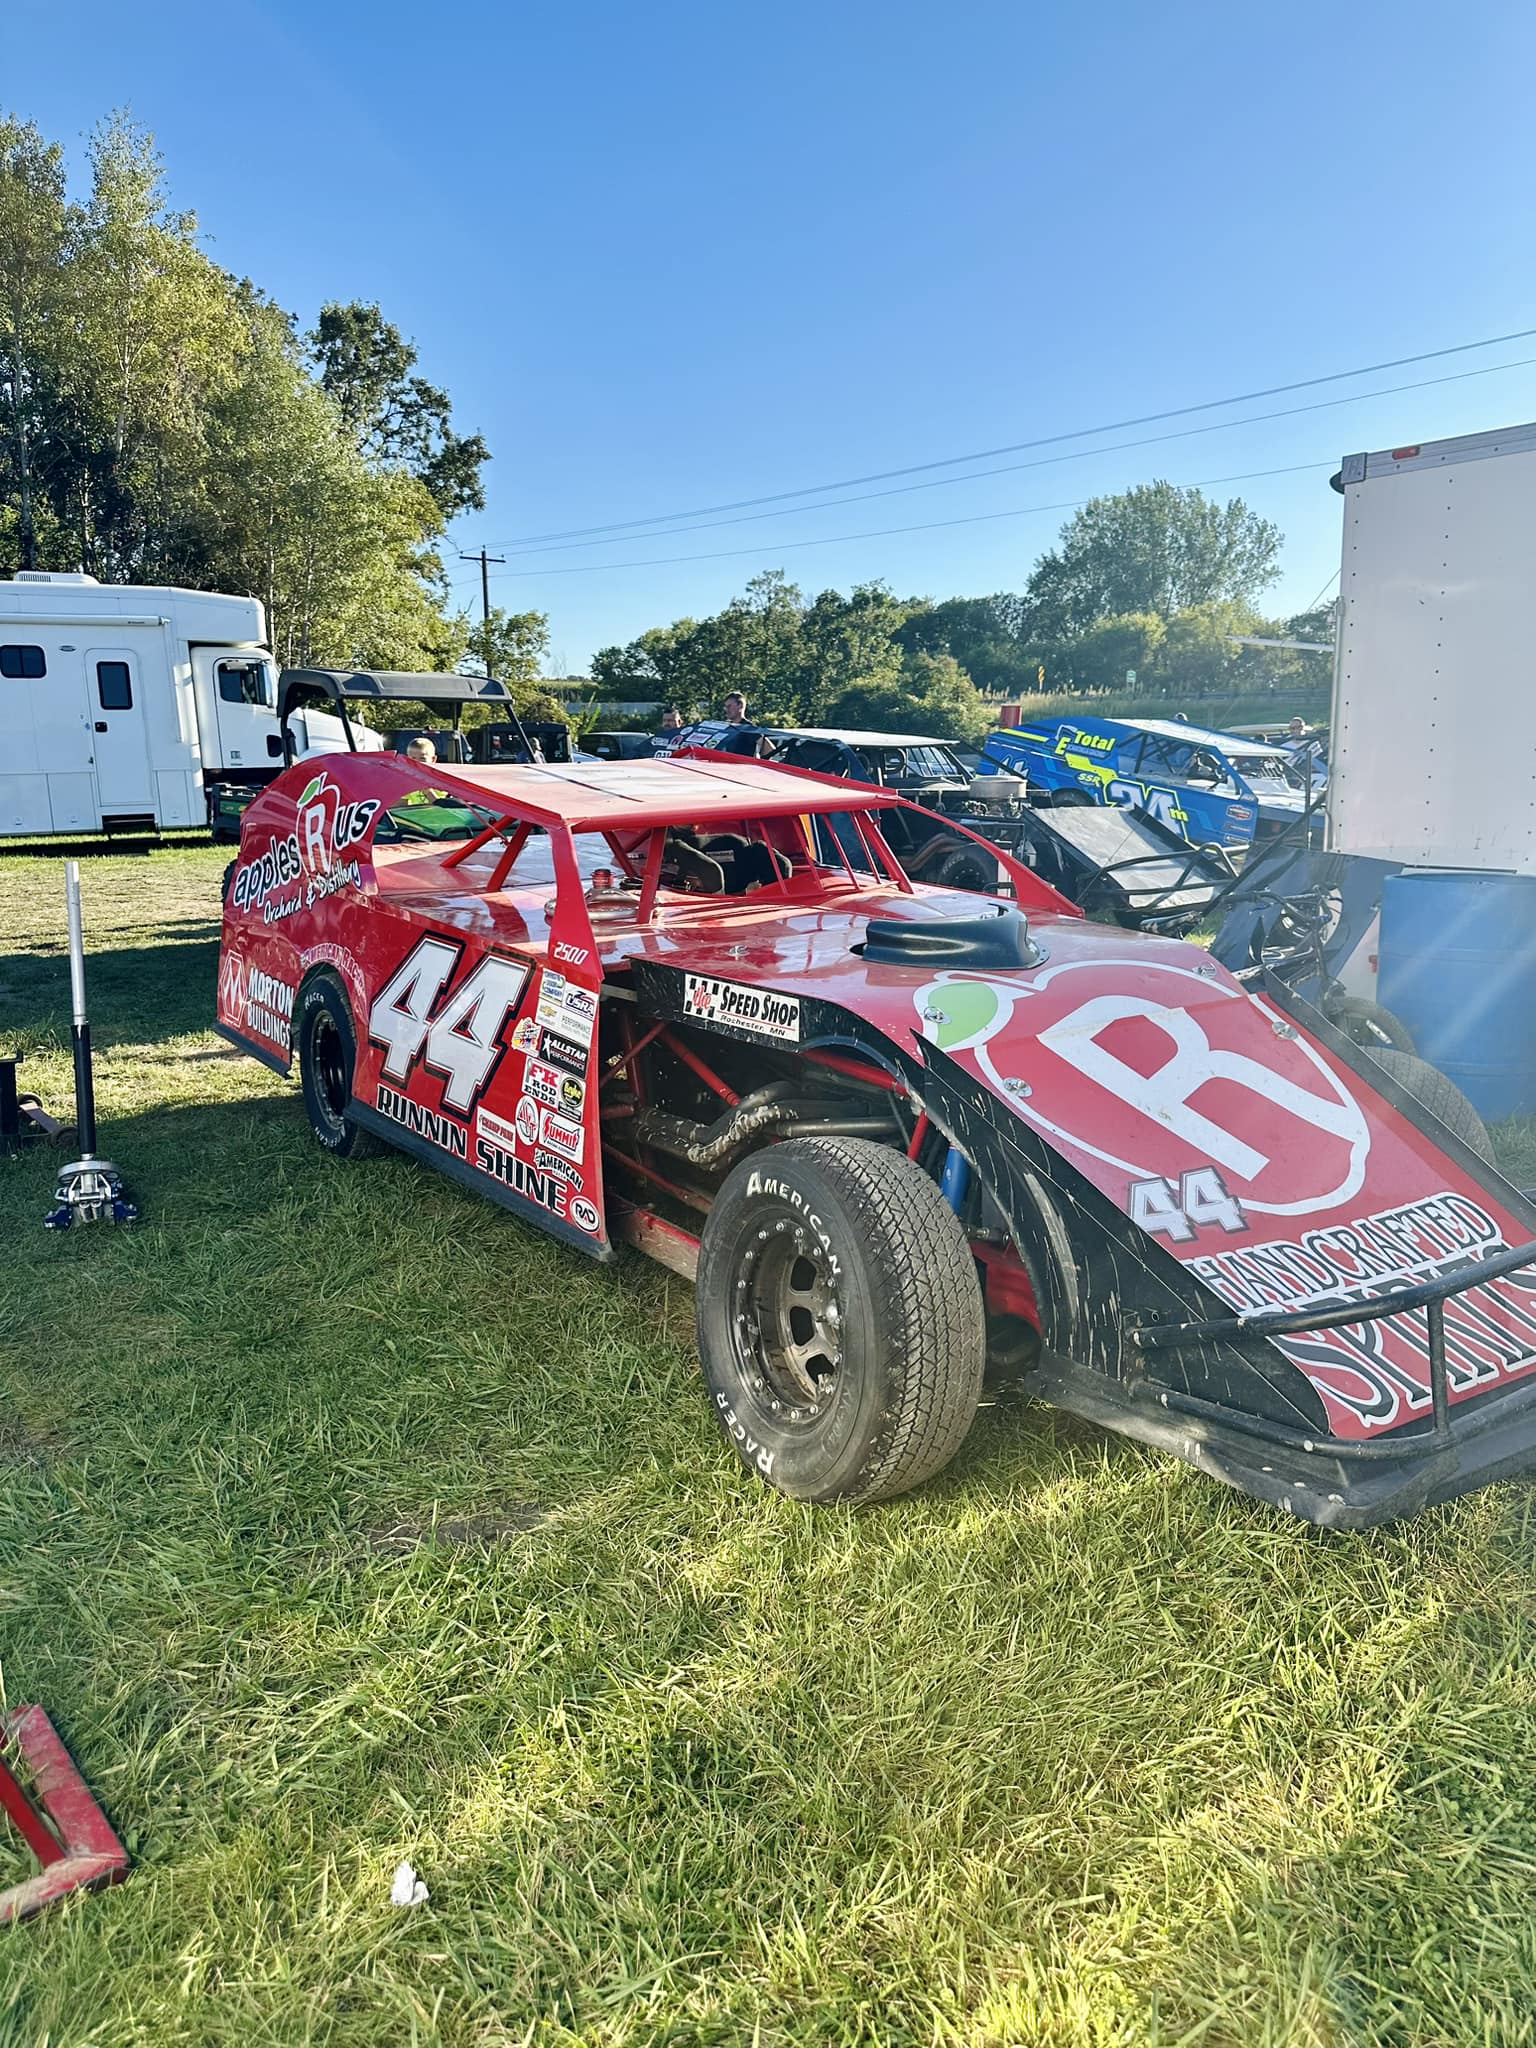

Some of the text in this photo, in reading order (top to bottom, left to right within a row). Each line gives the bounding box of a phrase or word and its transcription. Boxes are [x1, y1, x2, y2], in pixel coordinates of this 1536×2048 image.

[1074, 730, 1116, 751] Total
[233, 834, 302, 913] apples
[304, 803, 328, 872] R
[263, 859, 362, 925] Orchard & Distillery
[554, 941, 589, 965] 2500
[248, 968, 294, 1017] MORTON
[566, 993, 595, 1016] USRA
[693, 985, 799, 1028] the SPEED SHOP
[248, 1002, 291, 1050] BUILDINGS
[369, 932, 534, 1117] 44
[770, 1027, 785, 1036] MN
[551, 1040, 587, 1061] ALLSTAR
[551, 1050, 585, 1071] PERFORMANCE
[524, 1085, 556, 1105] ENDS
[529, 1063, 559, 1088] FK
[532, 1080, 557, 1096] ROD
[1036, 995, 1356, 1182] R
[376, 1084, 468, 1158] RUNNIN
[476, 1138, 568, 1217] SHINE
[539, 1152, 583, 1190] AMERICAN
[575, 1203, 596, 1224] RAD
[746, 1171, 841, 1274] AMERICAN
[1128, 1165, 1248, 1244] 44
[1182, 1191, 1503, 1318] HANDCRAFTED
[717, 1391, 776, 1475] RACER
